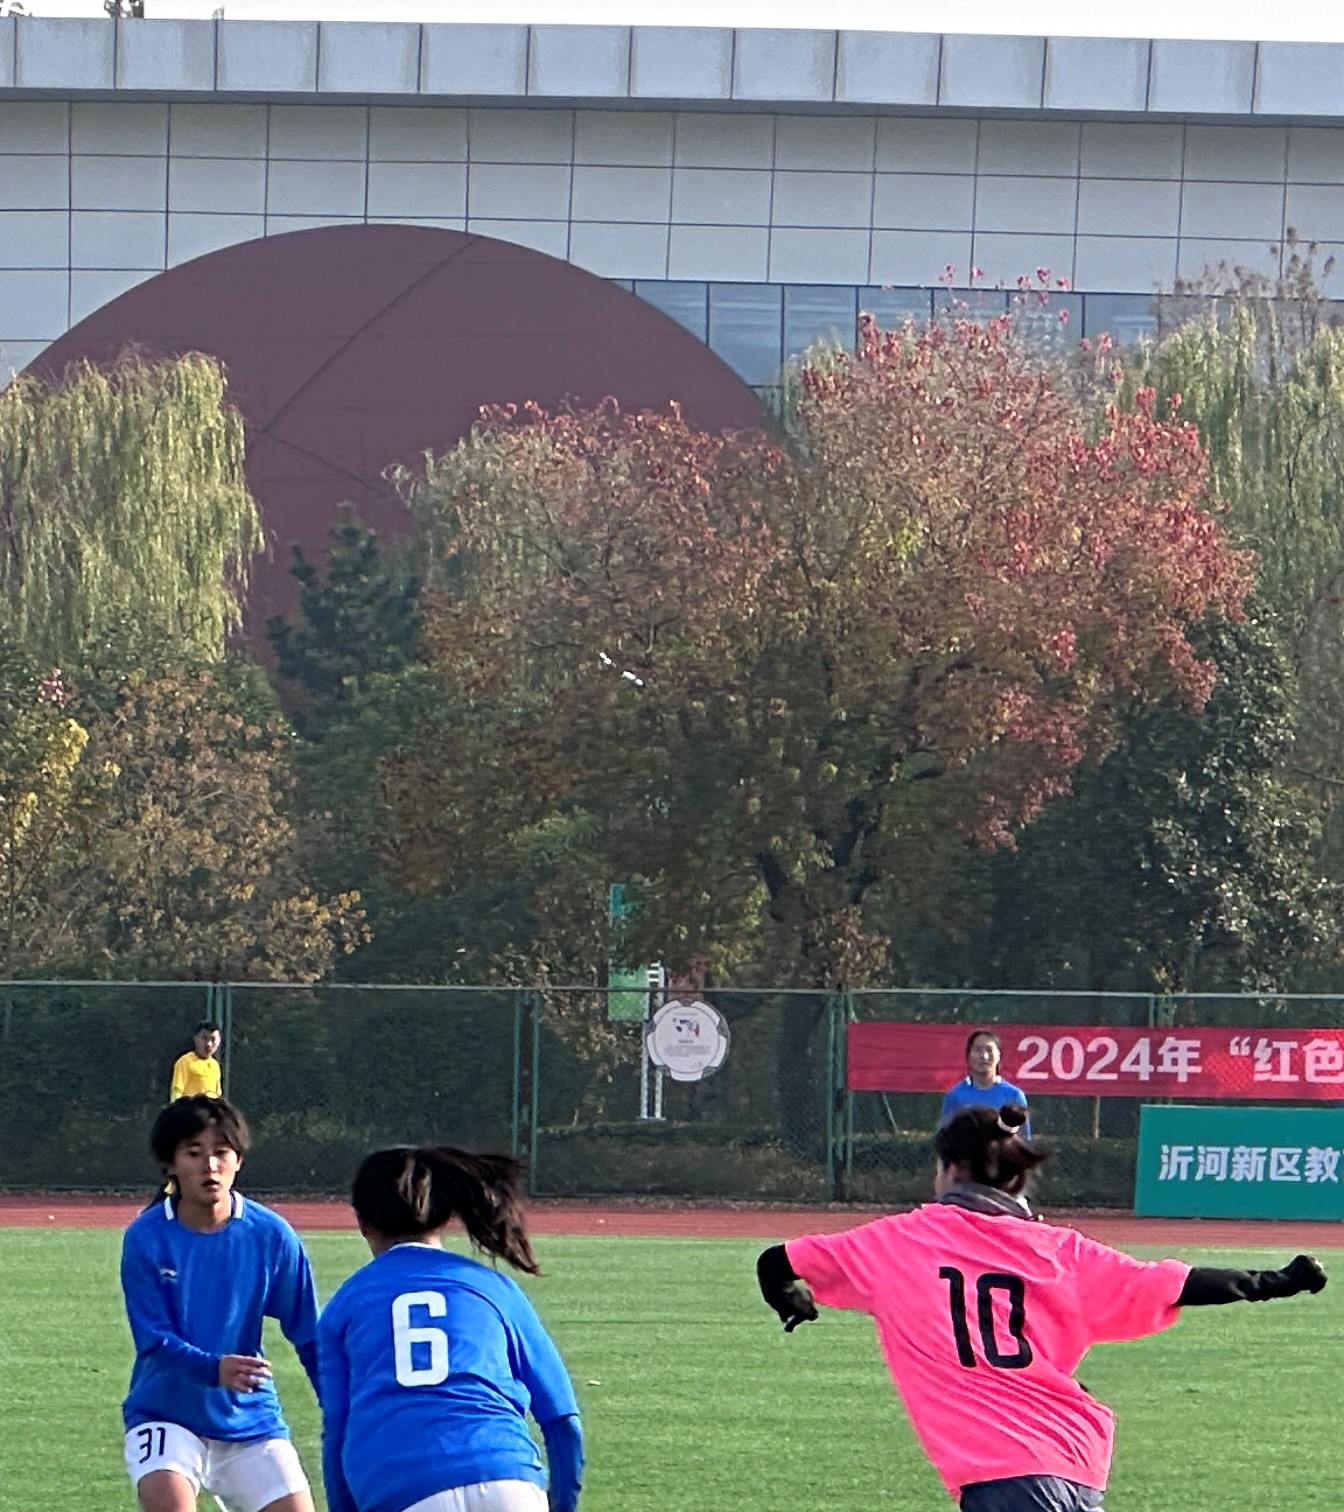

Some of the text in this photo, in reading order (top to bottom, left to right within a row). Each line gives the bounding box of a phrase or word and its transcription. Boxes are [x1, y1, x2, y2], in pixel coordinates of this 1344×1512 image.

[1016, 1034, 1204, 1085] 2024年
[391, 1291, 450, 1387] 6
[938, 1265, 1034, 1369] 10
[136, 1426, 167, 1465] 31
